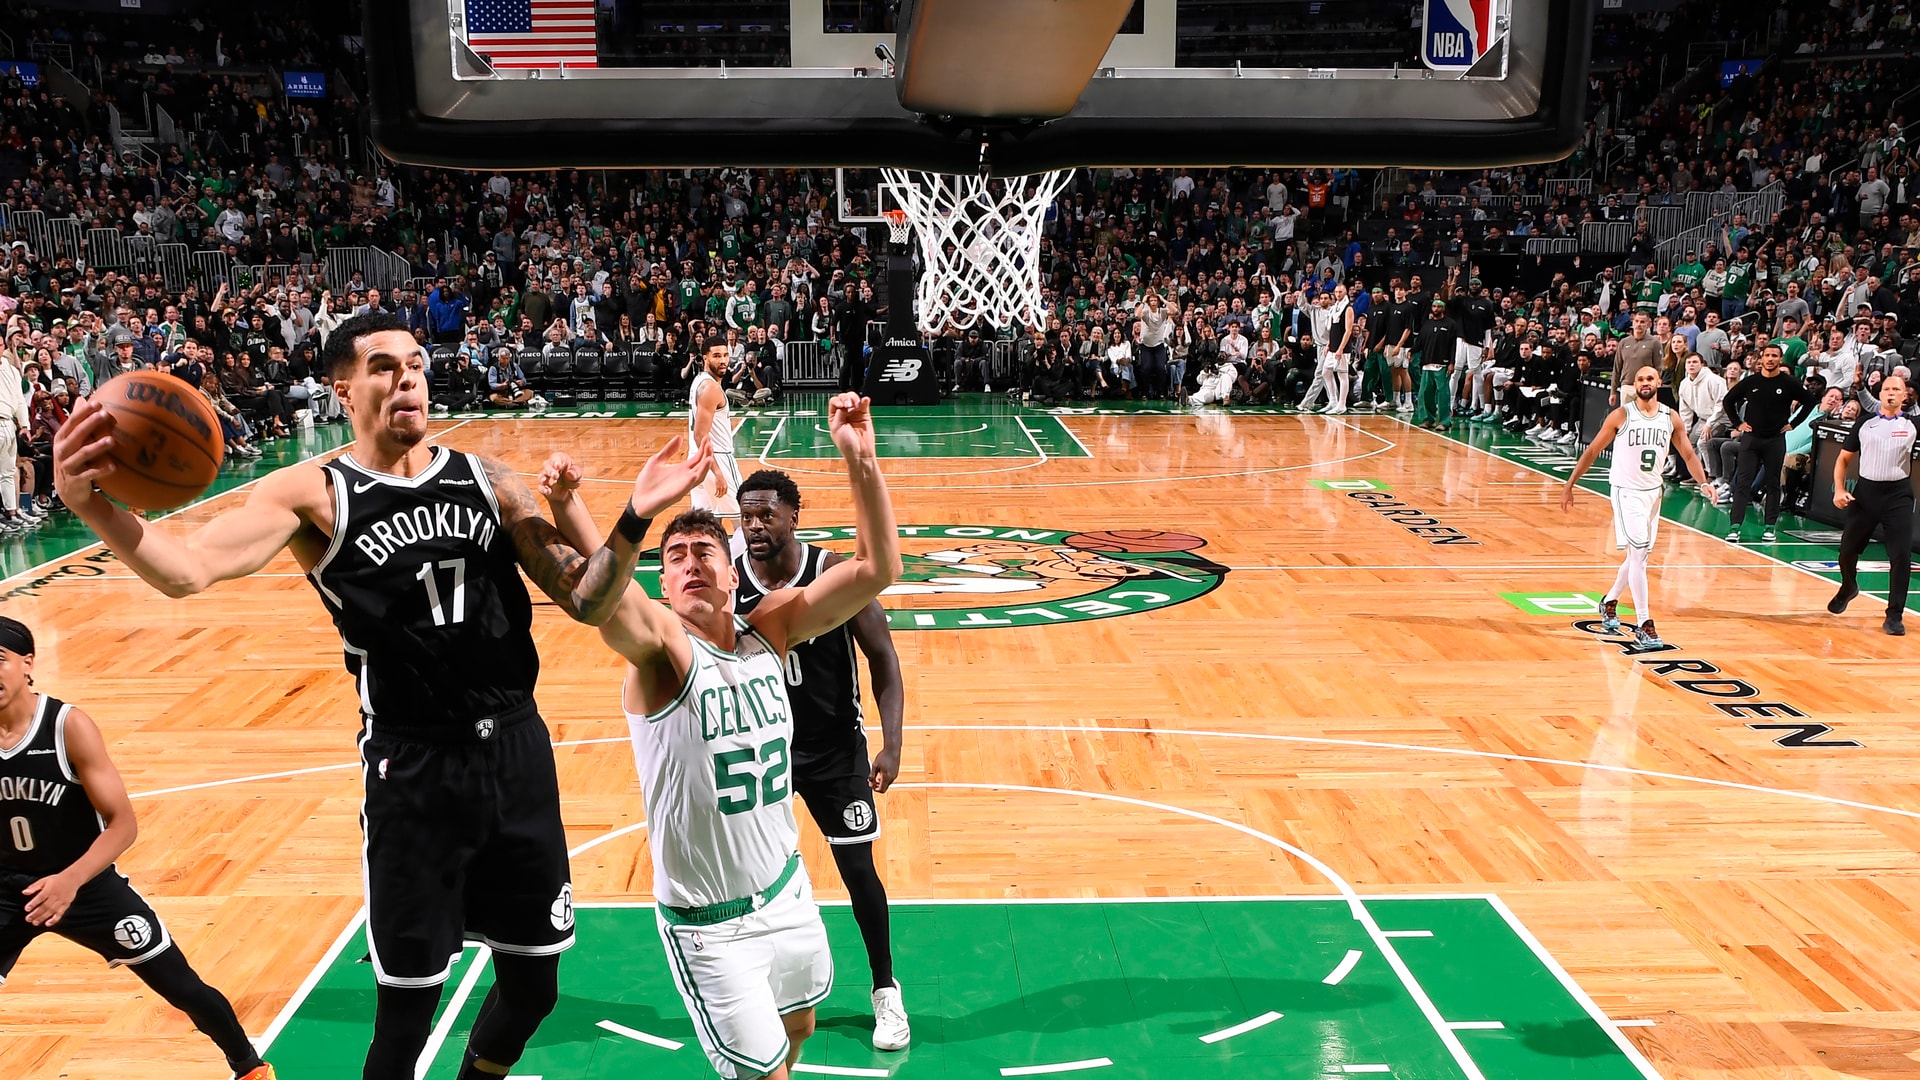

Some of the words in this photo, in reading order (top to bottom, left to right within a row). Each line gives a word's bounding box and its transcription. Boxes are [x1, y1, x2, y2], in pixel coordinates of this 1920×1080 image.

[1433, 32, 1464, 58] NBA
[1728, 274, 1737, 284] 0
[260, 344, 266, 354] 0
[885, 337, 916, 347] Amica
[576, 391, 598, 400] jetBlue
[605, 391, 627, 400] jetBlue
[636, 410, 818, 418] CETICS
[1628, 428, 1668, 447] CELTICS
[1640, 450, 1656, 471] 9
[1346, 492, 1485, 546] GARDEN
[355, 503, 495, 566] BROOKLYN
[794, 526, 1056, 541] OTON
[416, 558, 465, 626] 17
[886, 591, 1171, 626] CELTI
[1571, 619, 1865, 748] GARDEN
[701, 675, 787, 742] CELICS
[714, 737, 788, 816] 52
[0, 776, 66, 806] OKLYN
[10, 816, 34, 851] 0
